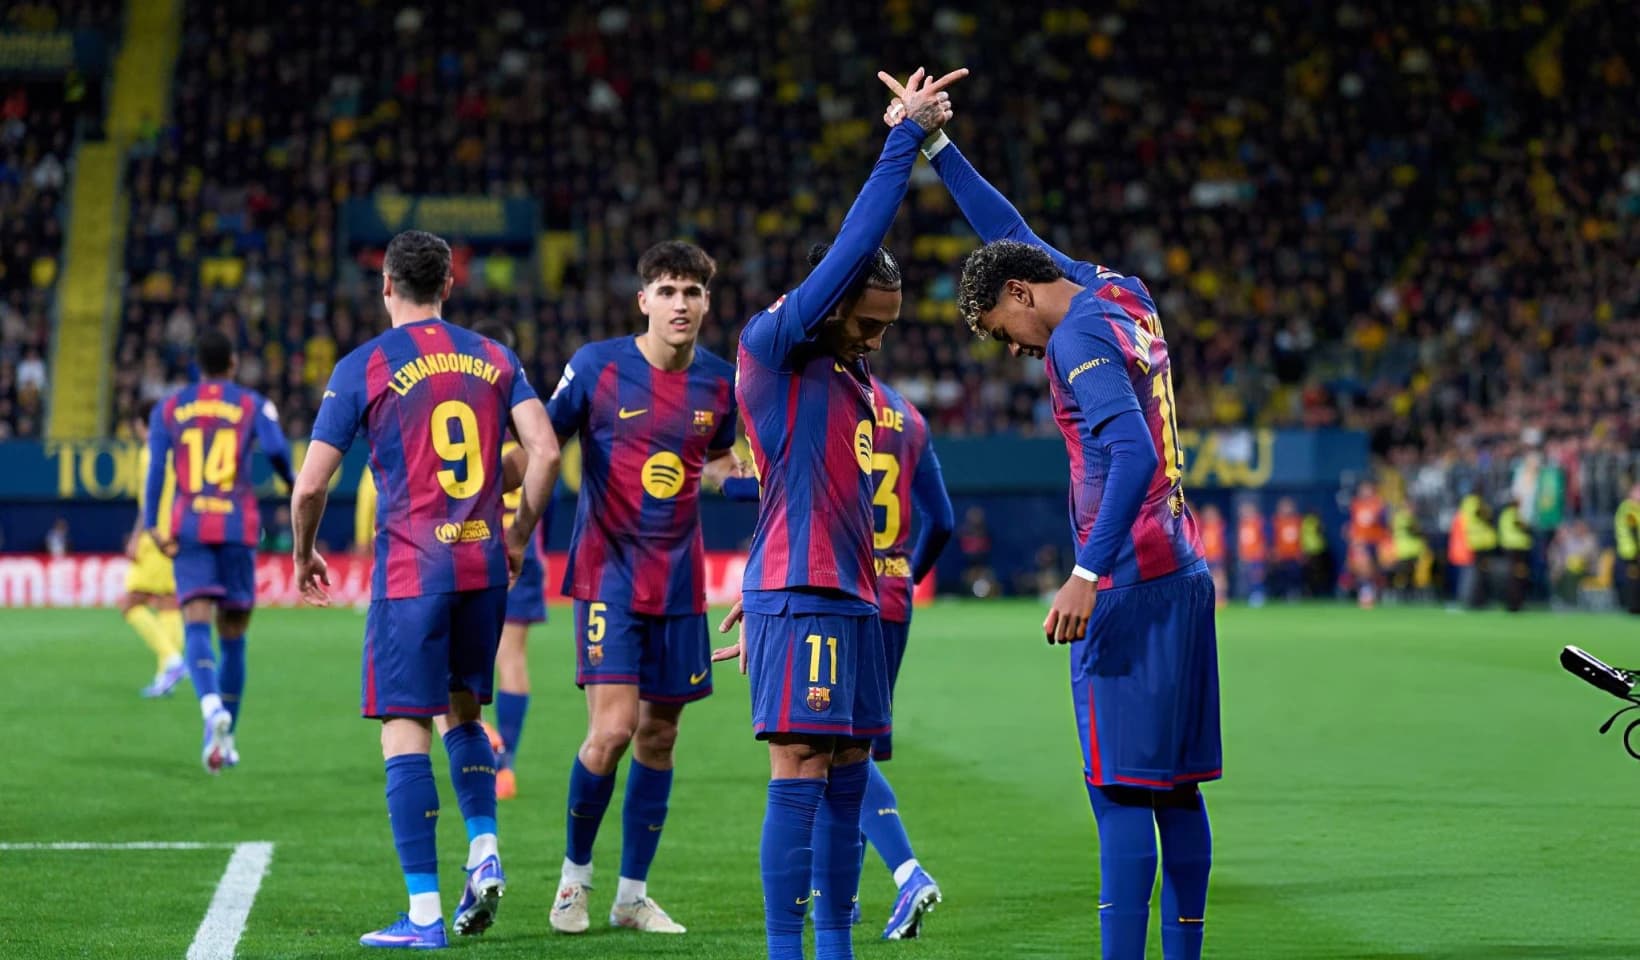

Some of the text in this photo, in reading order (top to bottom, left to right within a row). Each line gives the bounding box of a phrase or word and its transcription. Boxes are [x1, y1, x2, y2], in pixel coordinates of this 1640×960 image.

[387, 353, 501, 397] LEWANDOWSKI
[181, 427, 236, 493] 14
[431, 400, 485, 499] 9
[588, 602, 607, 642] 5
[805, 634, 837, 684] 11
